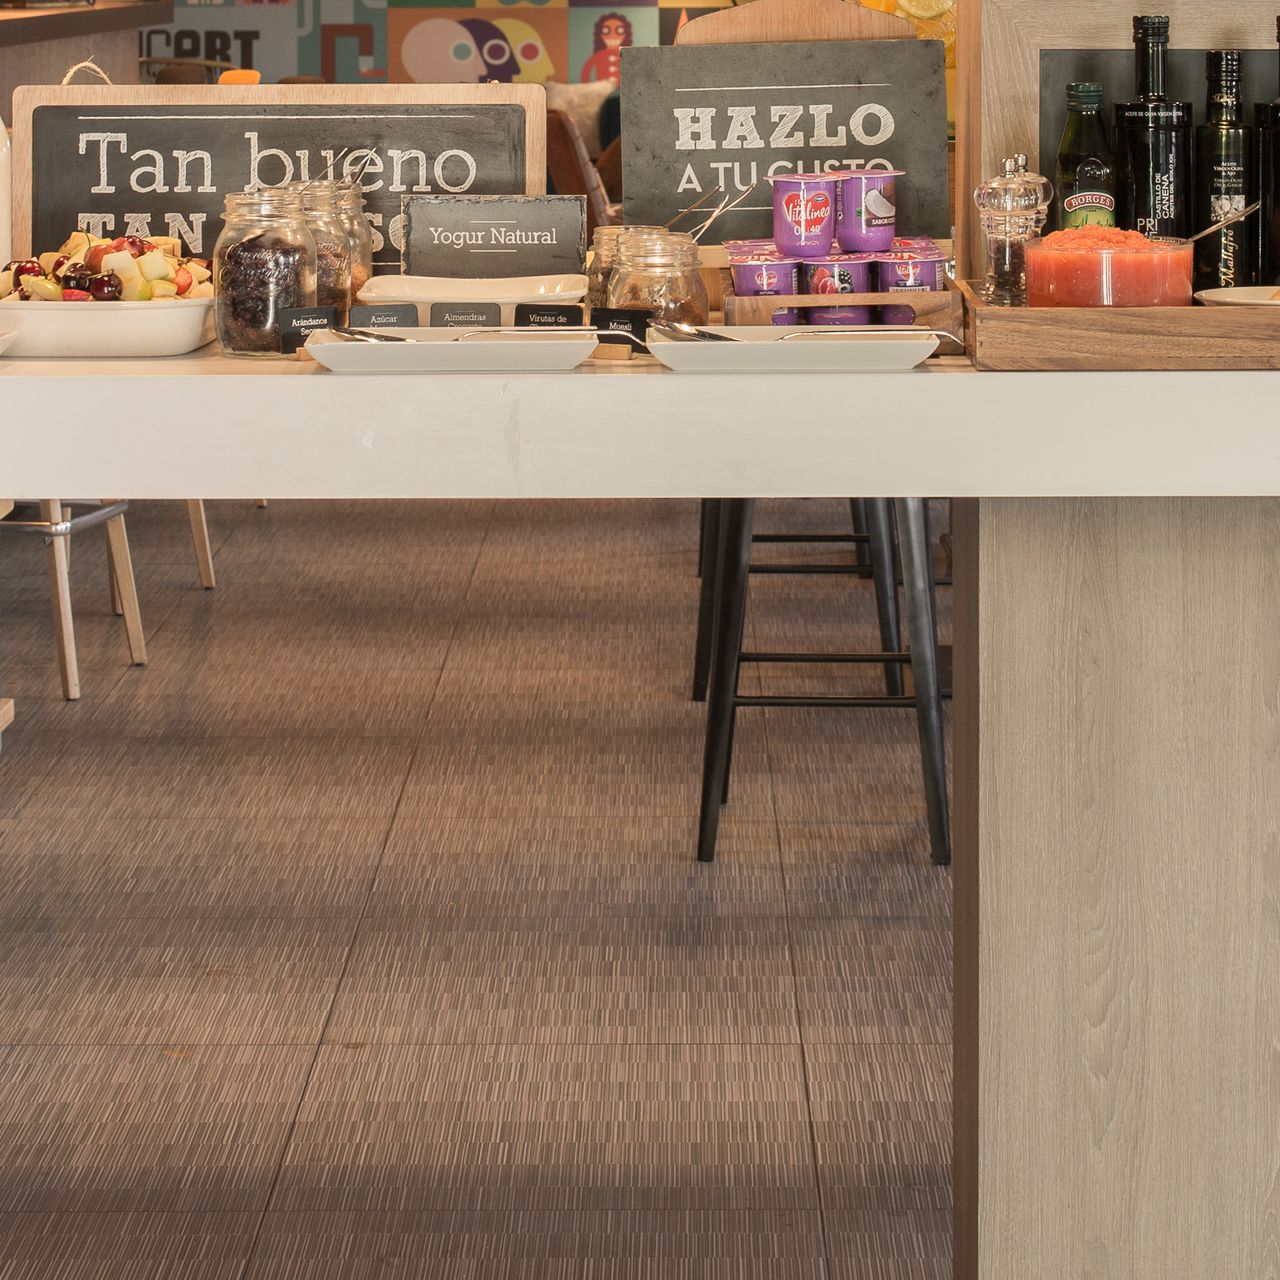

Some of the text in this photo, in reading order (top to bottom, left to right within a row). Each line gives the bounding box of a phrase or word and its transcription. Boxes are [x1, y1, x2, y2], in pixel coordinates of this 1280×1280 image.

[673, 103, 895, 150] HAZLO
[78, 131, 477, 195] Tan bueno
[677, 163, 703, 193] A
[710, 162, 757, 193] TU
[1155, 173, 1161, 184] DE
[1070, 195, 1111, 207] BORGES
[1162, 174, 1170, 219] CANENA
[1137, 218, 1157, 231] PRI
[78, 212, 207, 254] TAN
[429, 228, 483, 251] Yogur
[490, 227, 557, 245] Natural
[292, 318, 328, 328] Arándanos
[371, 315, 398, 324] Azúcar
[444, 313, 486, 321] Almendras
[529, 314, 567, 323] Virutas de
[609, 321, 632, 332] Muesli
